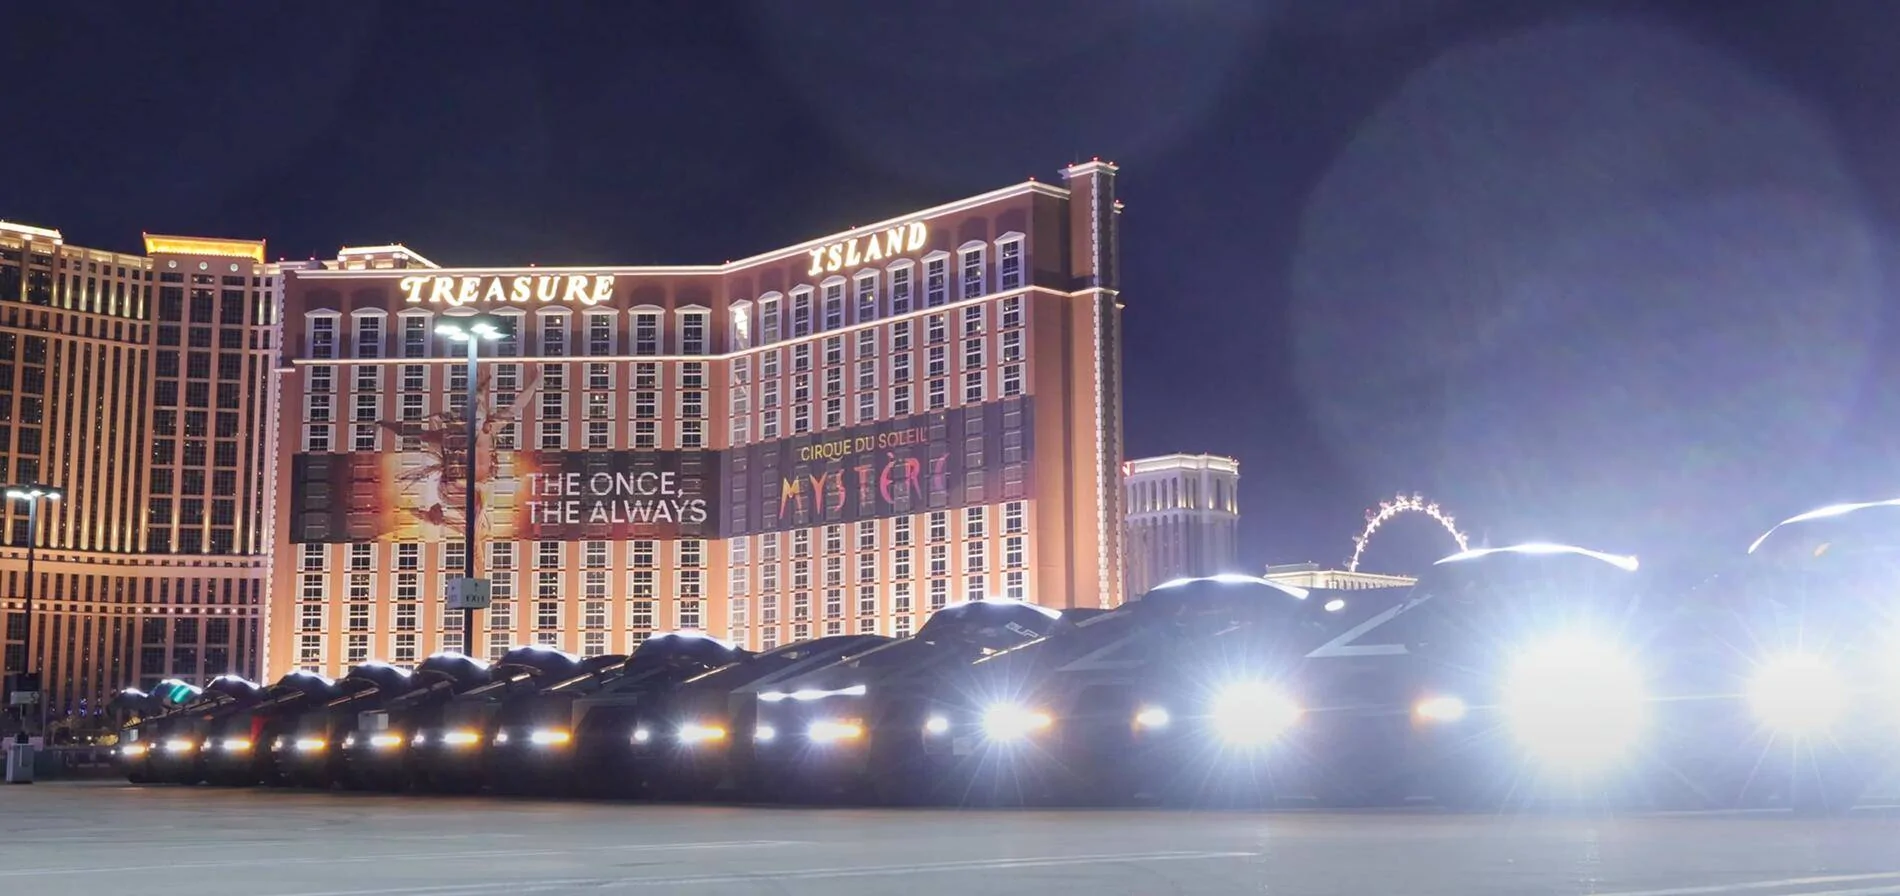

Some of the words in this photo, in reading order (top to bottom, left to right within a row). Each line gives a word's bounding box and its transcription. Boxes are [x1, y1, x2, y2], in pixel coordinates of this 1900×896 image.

[400, 275, 616, 306] TREASURE
[808, 221, 927, 277] ISLAND
[800, 439, 852, 462] CIRQUE
[855, 436, 875, 451] DU
[878, 426, 928, 448] SOLEIL
[526, 472, 581, 496] THE
[590, 471, 684, 499] ONCE,
[525, 500, 580, 524] THE
[589, 499, 708, 524] ALWAYS
